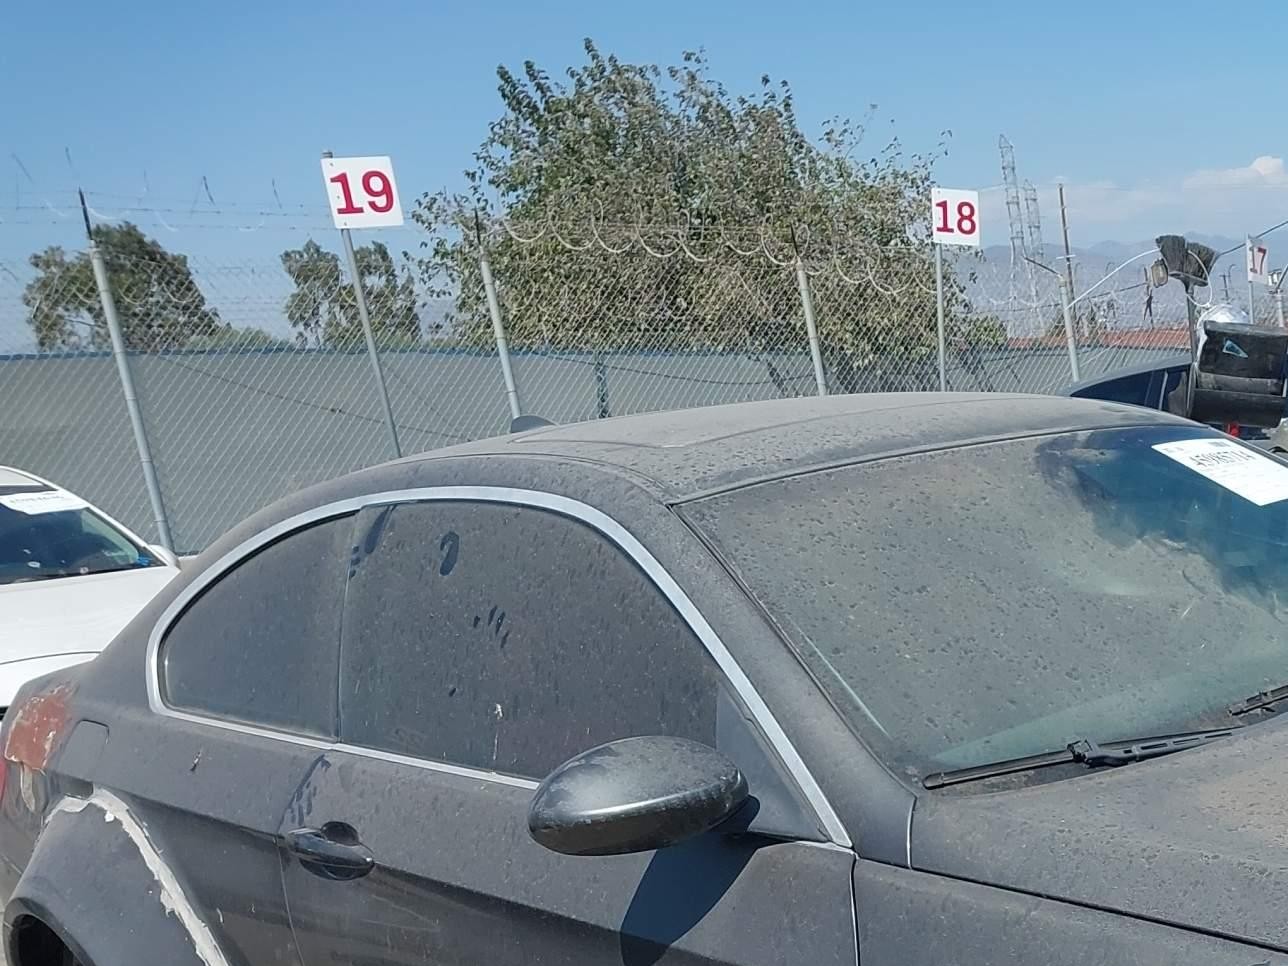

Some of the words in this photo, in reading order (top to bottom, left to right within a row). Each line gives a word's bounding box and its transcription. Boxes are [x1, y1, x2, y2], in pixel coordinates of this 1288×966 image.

[330, 170, 394, 214] 19
[936, 200, 976, 235] 18
[1249, 245, 1267, 275] 17
